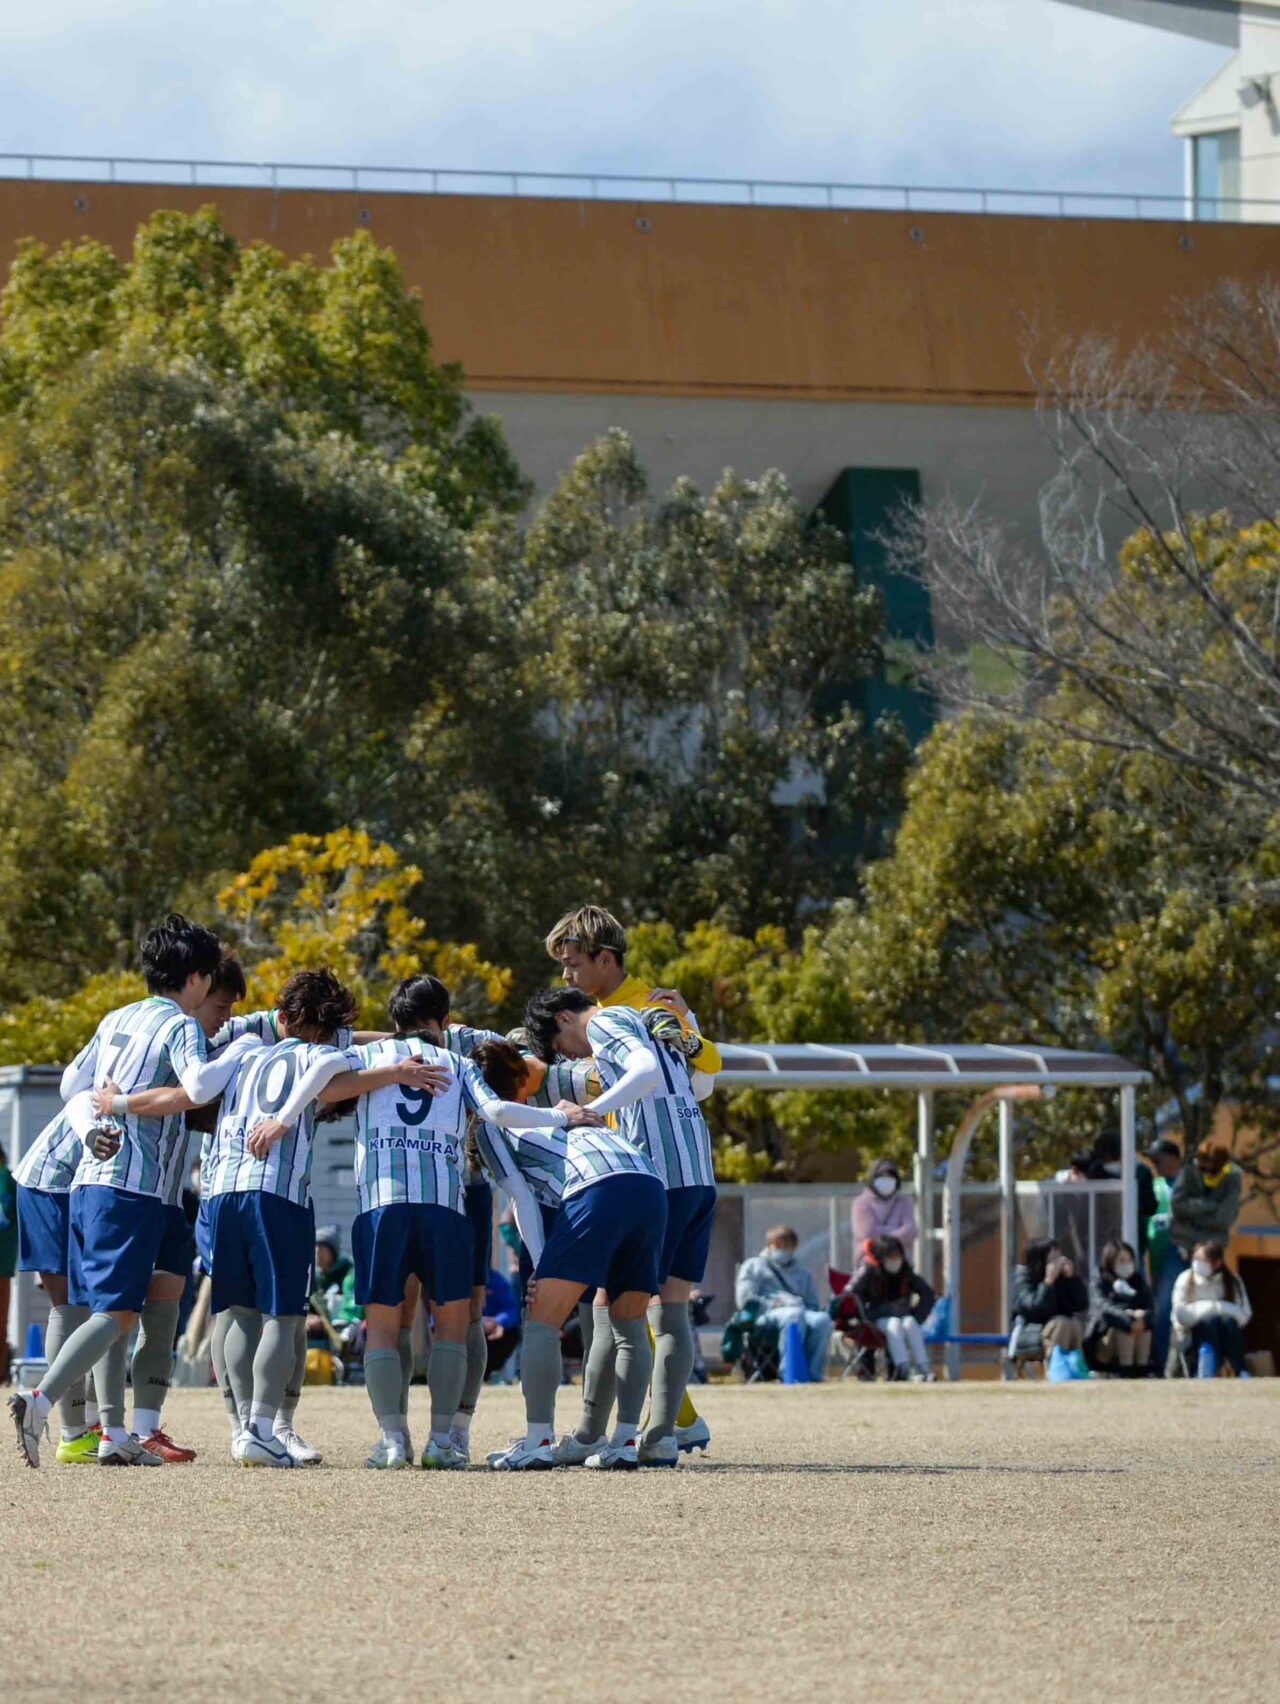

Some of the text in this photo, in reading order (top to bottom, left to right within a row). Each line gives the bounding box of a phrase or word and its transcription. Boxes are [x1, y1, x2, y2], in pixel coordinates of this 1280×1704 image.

[107, 1031, 133, 1078] 7
[230, 1051, 298, 1116] 10
[396, 1066, 435, 1126] 9
[369, 1137, 455, 1156] KITAMURA
